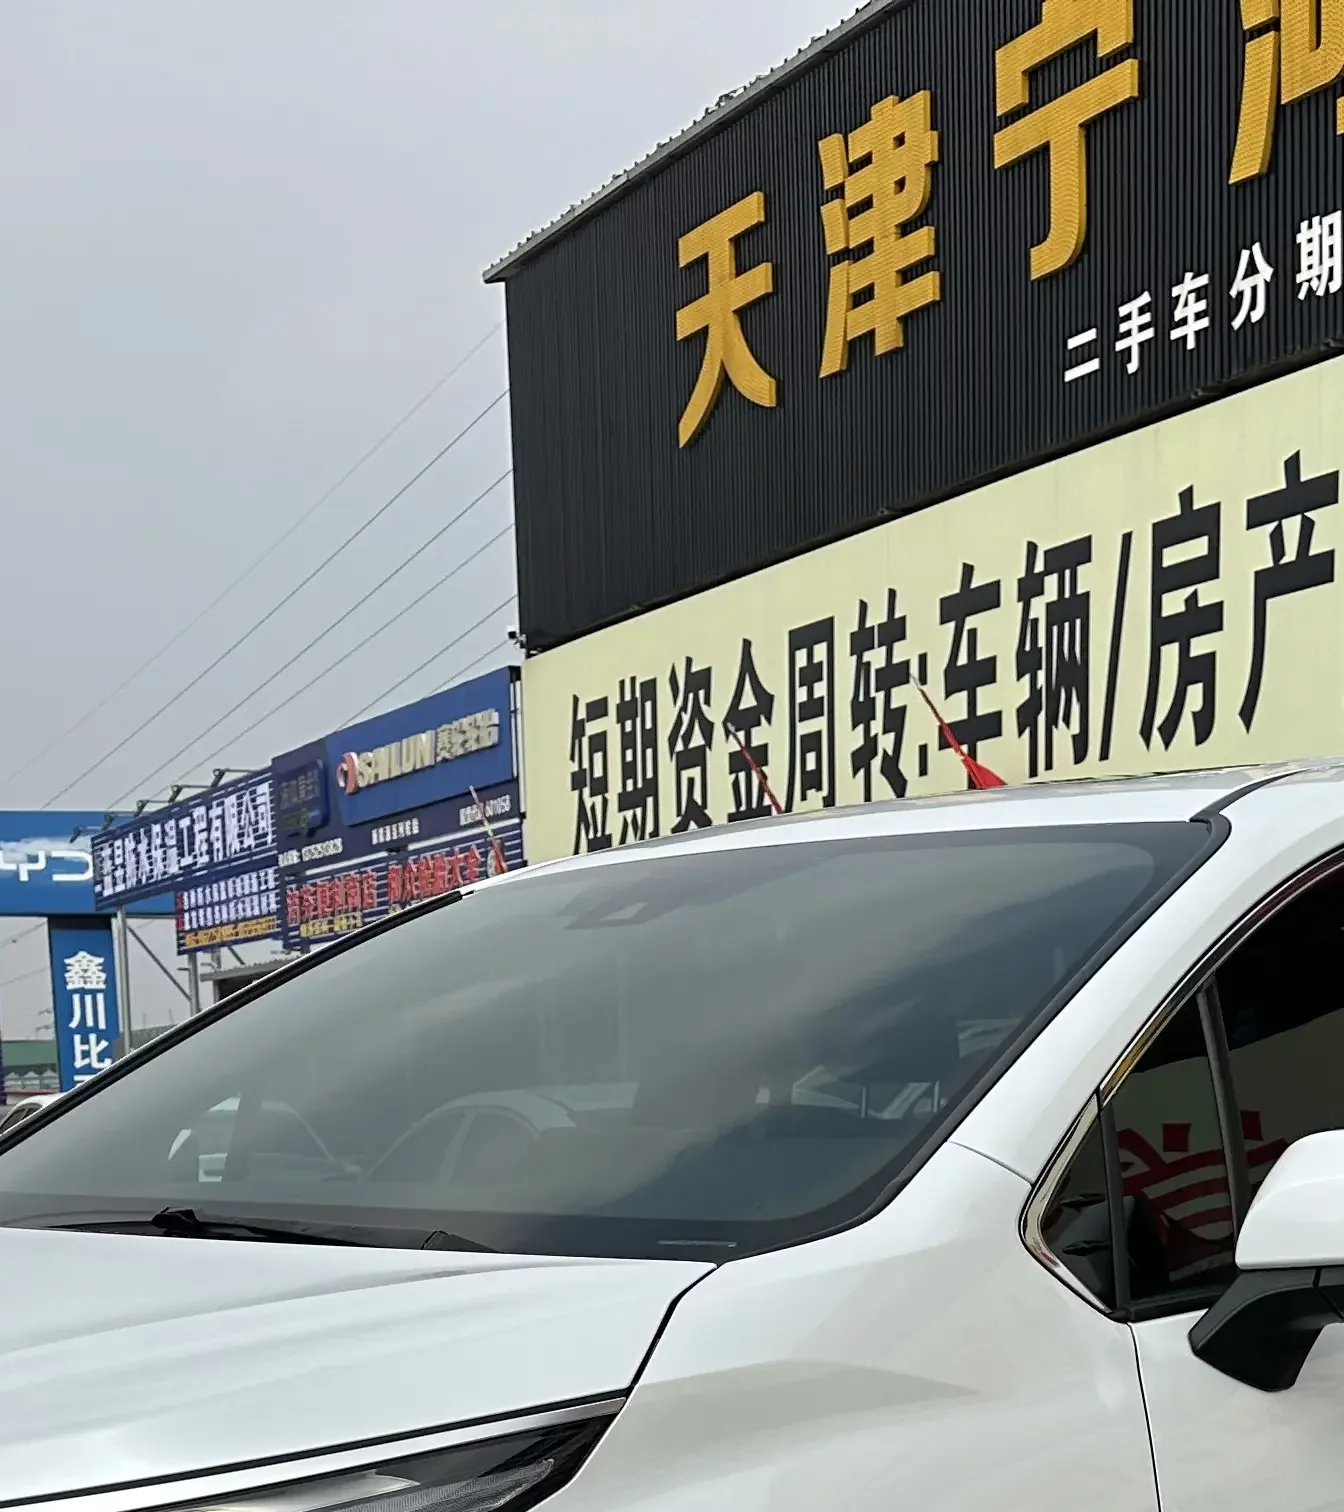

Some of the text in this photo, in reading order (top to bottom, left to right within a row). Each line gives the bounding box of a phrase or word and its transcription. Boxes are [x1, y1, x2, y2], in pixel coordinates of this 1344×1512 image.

[1063, 210, 1344, 384] 二手车分期
[358, 730, 436, 788] SAILUN
